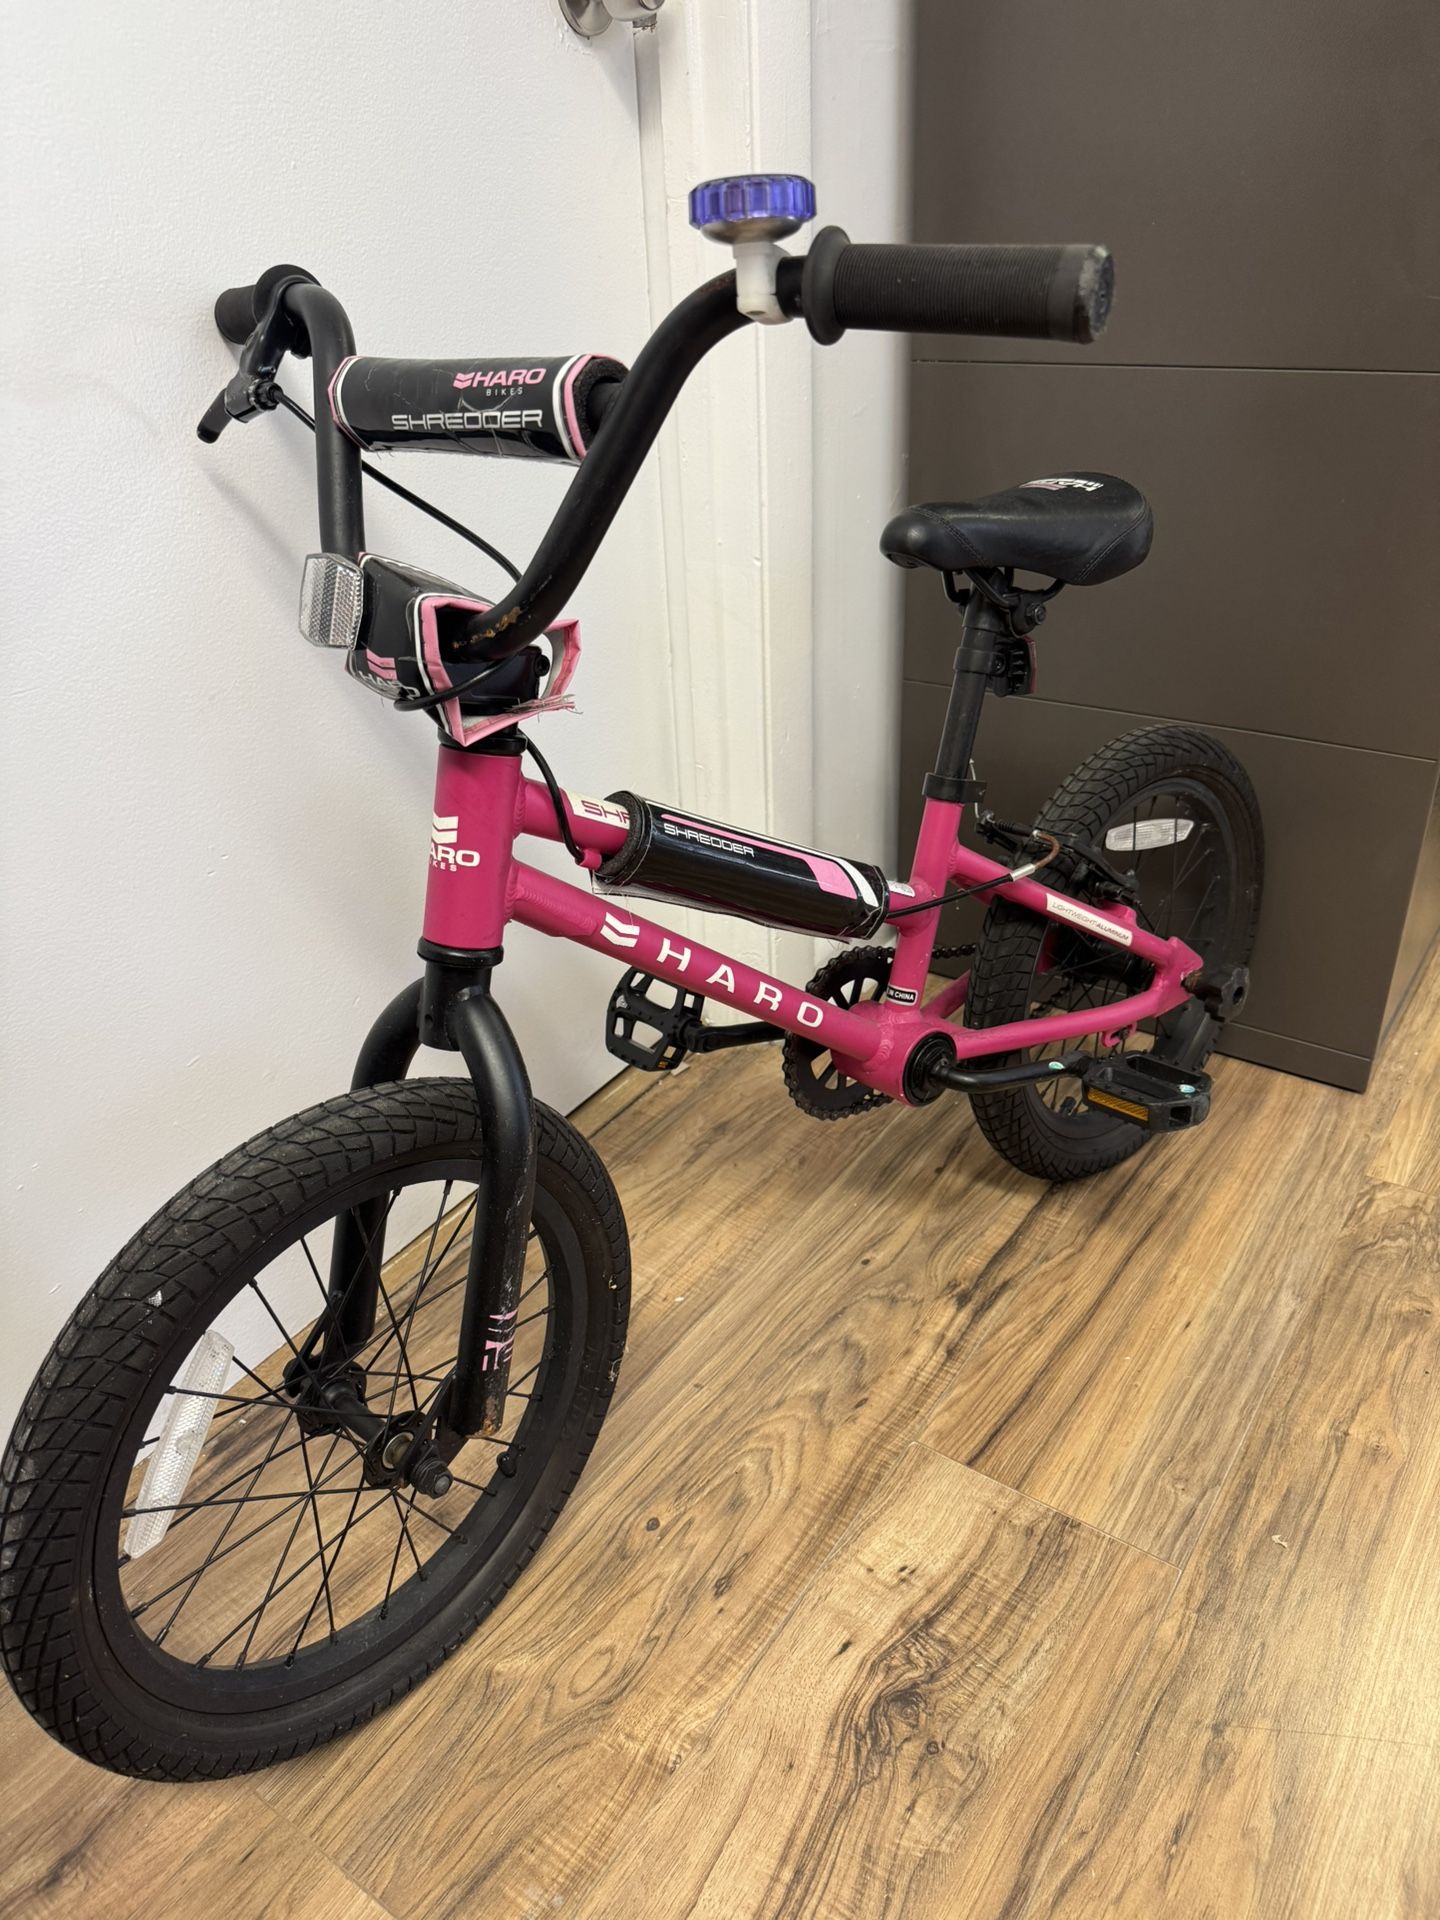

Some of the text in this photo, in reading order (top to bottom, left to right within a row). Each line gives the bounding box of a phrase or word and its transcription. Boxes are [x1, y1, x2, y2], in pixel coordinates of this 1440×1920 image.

[472, 368, 547, 388] HARO
[486, 387, 523, 396] BIKES
[392, 409, 543, 430] SHREDDER
[663, 822, 755, 858] SHREDDER
[430, 842, 481, 867] ARO
[1052, 901, 1097, 925] LIGHTWEIGHT
[656, 937, 824, 1029] HARO
[895, 990, 915, 1001] CHINA
